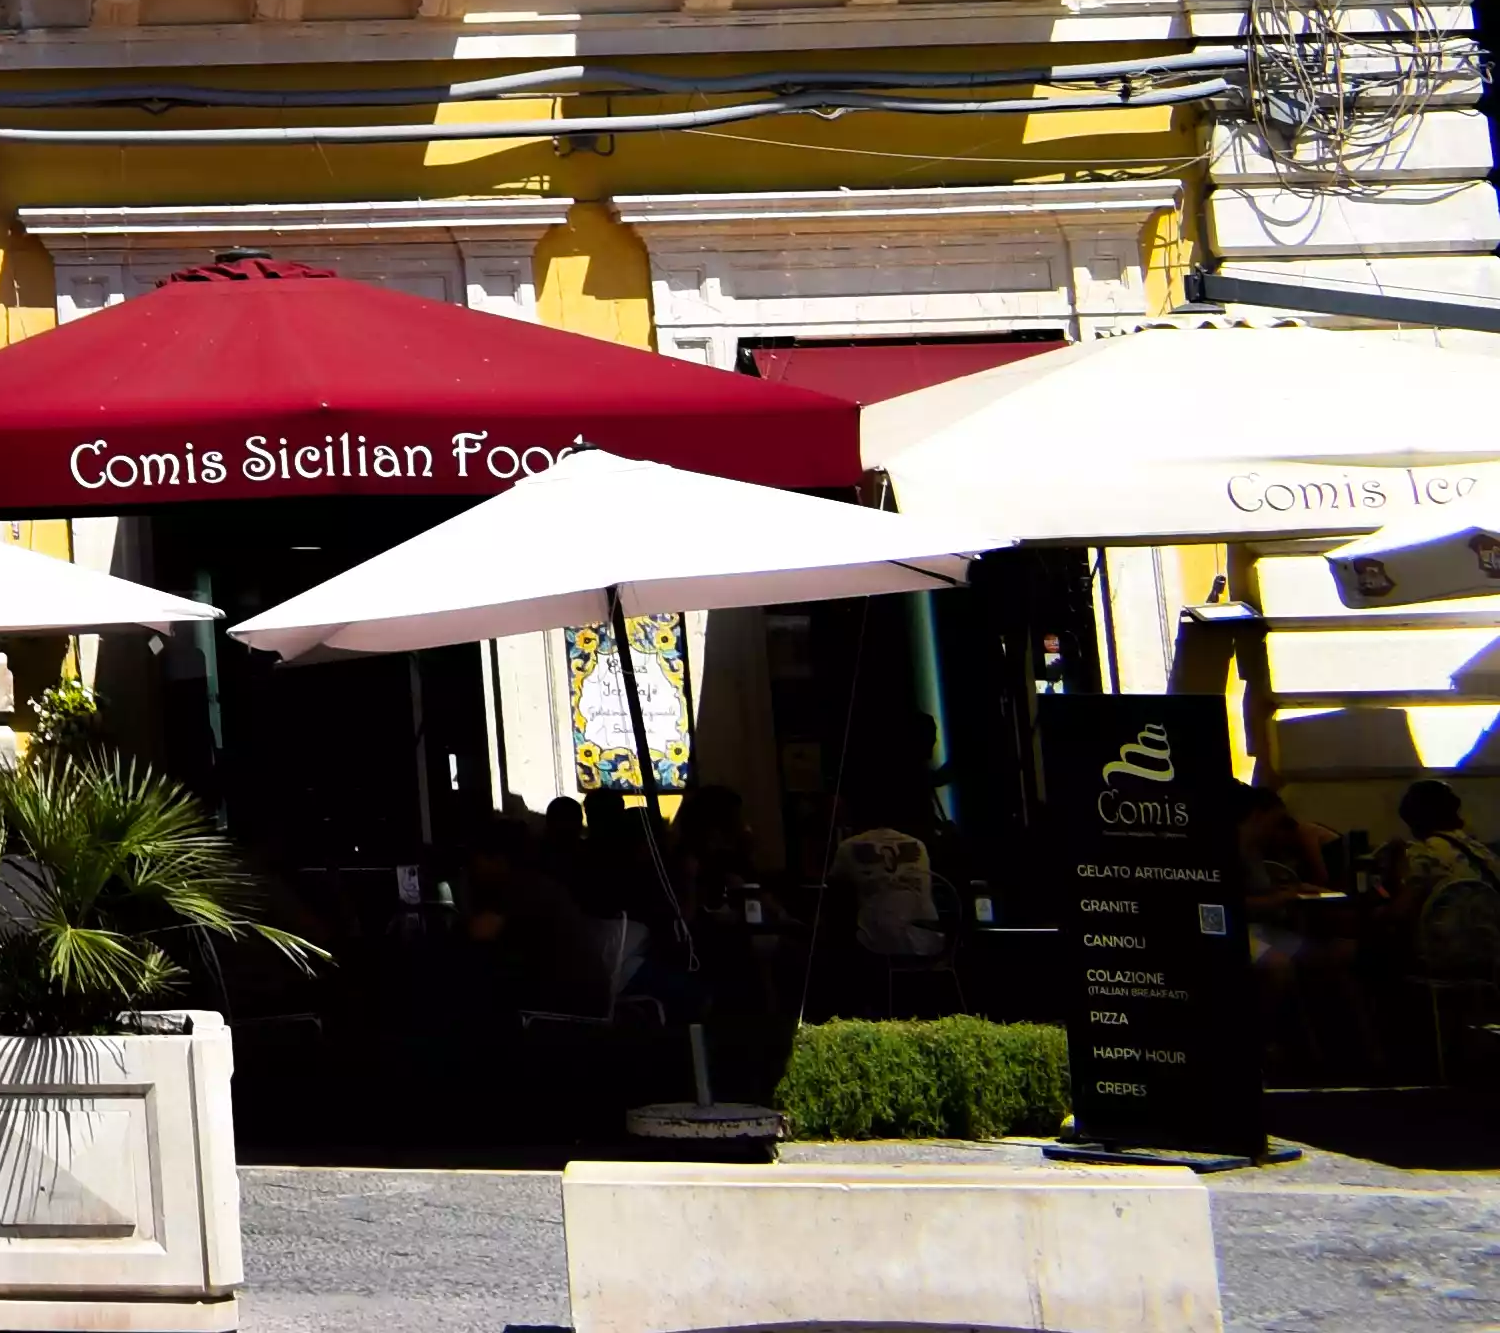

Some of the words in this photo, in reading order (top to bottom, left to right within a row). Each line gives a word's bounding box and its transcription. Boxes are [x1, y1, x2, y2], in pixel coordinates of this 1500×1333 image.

[69, 438, 228, 489] Comis
[241, 431, 434, 482] Sicilian
[1227, 472, 1387, 512] Comis
[1097, 788, 1189, 827] Comis
[1076, 864, 1131, 878] GELATO
[1135, 866, 1221, 883] ARTIGIANALE
[1080, 899, 1140, 914] GRANITE
[1083, 933, 1147, 949] CANNOLI
[1086, 968, 1165, 985] COLAZIONE
[1088, 985, 1129, 997] (ITALIAN
[1131, 987, 1189, 1001] BREAKFAST)
[1090, 1010, 1129, 1025] PIZZA
[1093, 1046, 1142, 1061] HAPPY
[1145, 1049, 1187, 1064] HOUR
[1096, 1081, 1148, 1097] CREPES
